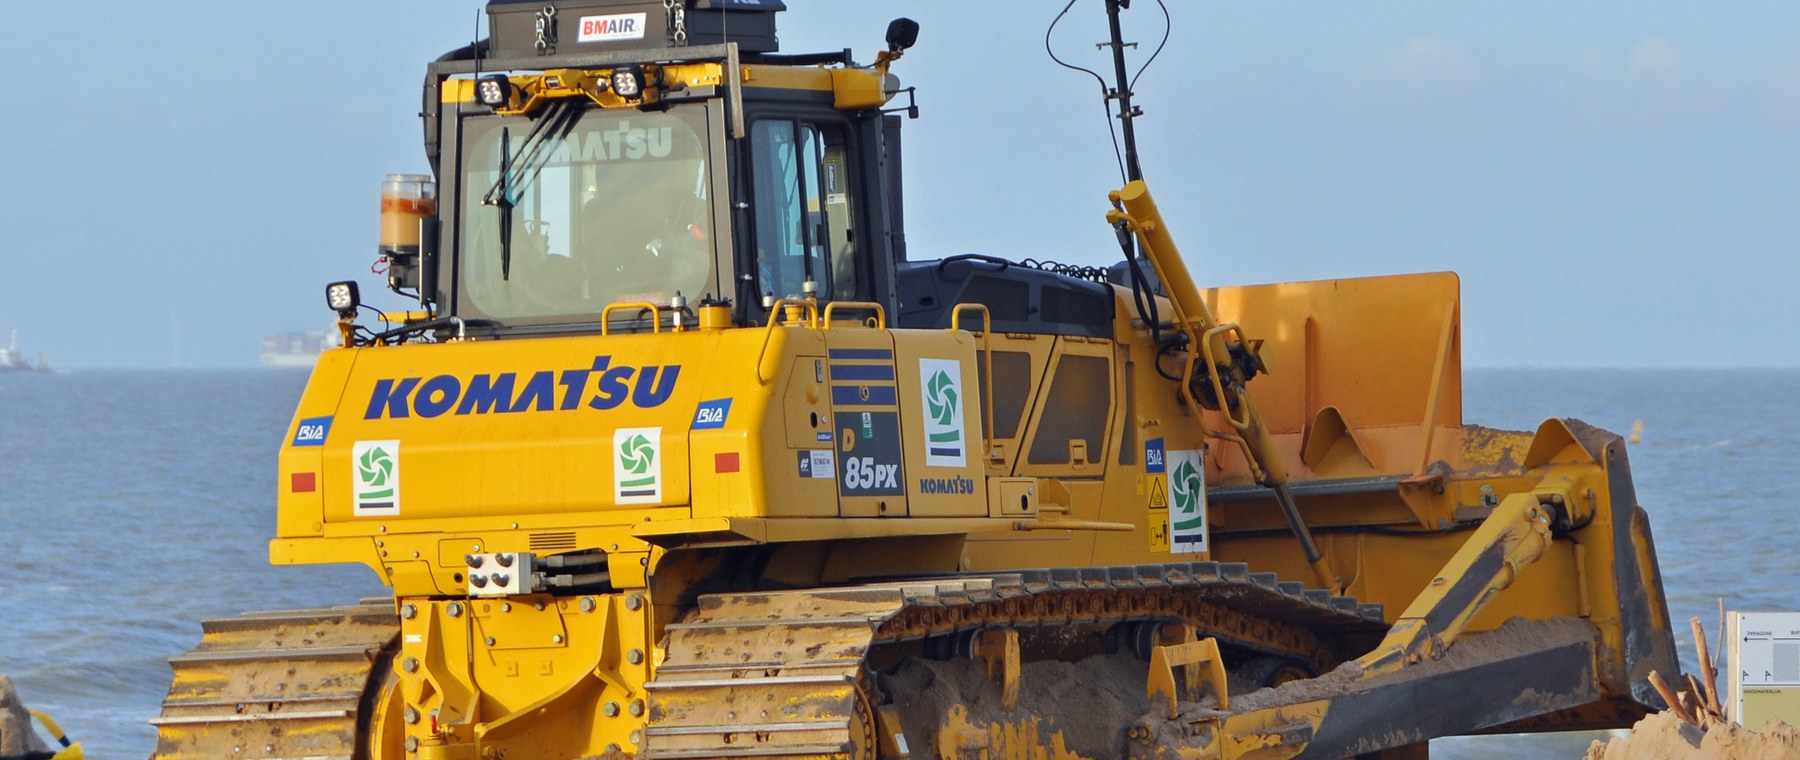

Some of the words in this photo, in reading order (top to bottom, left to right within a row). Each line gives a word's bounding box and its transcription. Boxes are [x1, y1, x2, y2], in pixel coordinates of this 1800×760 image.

[363, 355, 682, 420] KOMATSU
[842, 428, 856, 452] D
[845, 456, 898, 489] 85PX
[920, 474, 974, 495] KOMATSU
